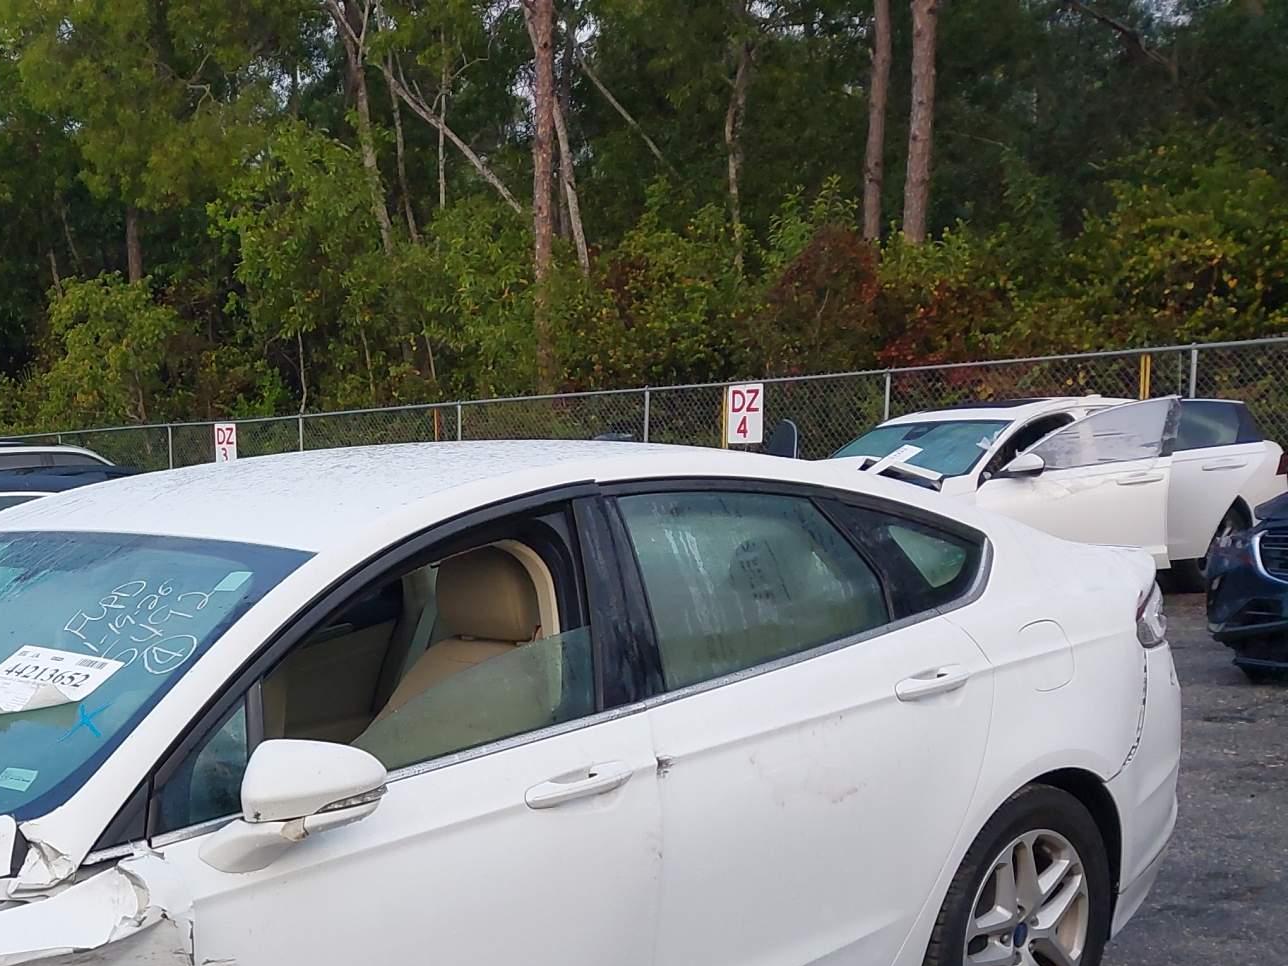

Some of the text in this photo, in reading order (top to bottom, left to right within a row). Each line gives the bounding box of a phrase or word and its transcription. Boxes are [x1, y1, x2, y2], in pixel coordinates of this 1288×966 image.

[731, 388, 760, 413] DZ
[216, 427, 235, 445] DZ
[736, 415, 748, 439] 4
[220, 447, 229, 461] 3
[4, 661, 91, 689] 44213652
